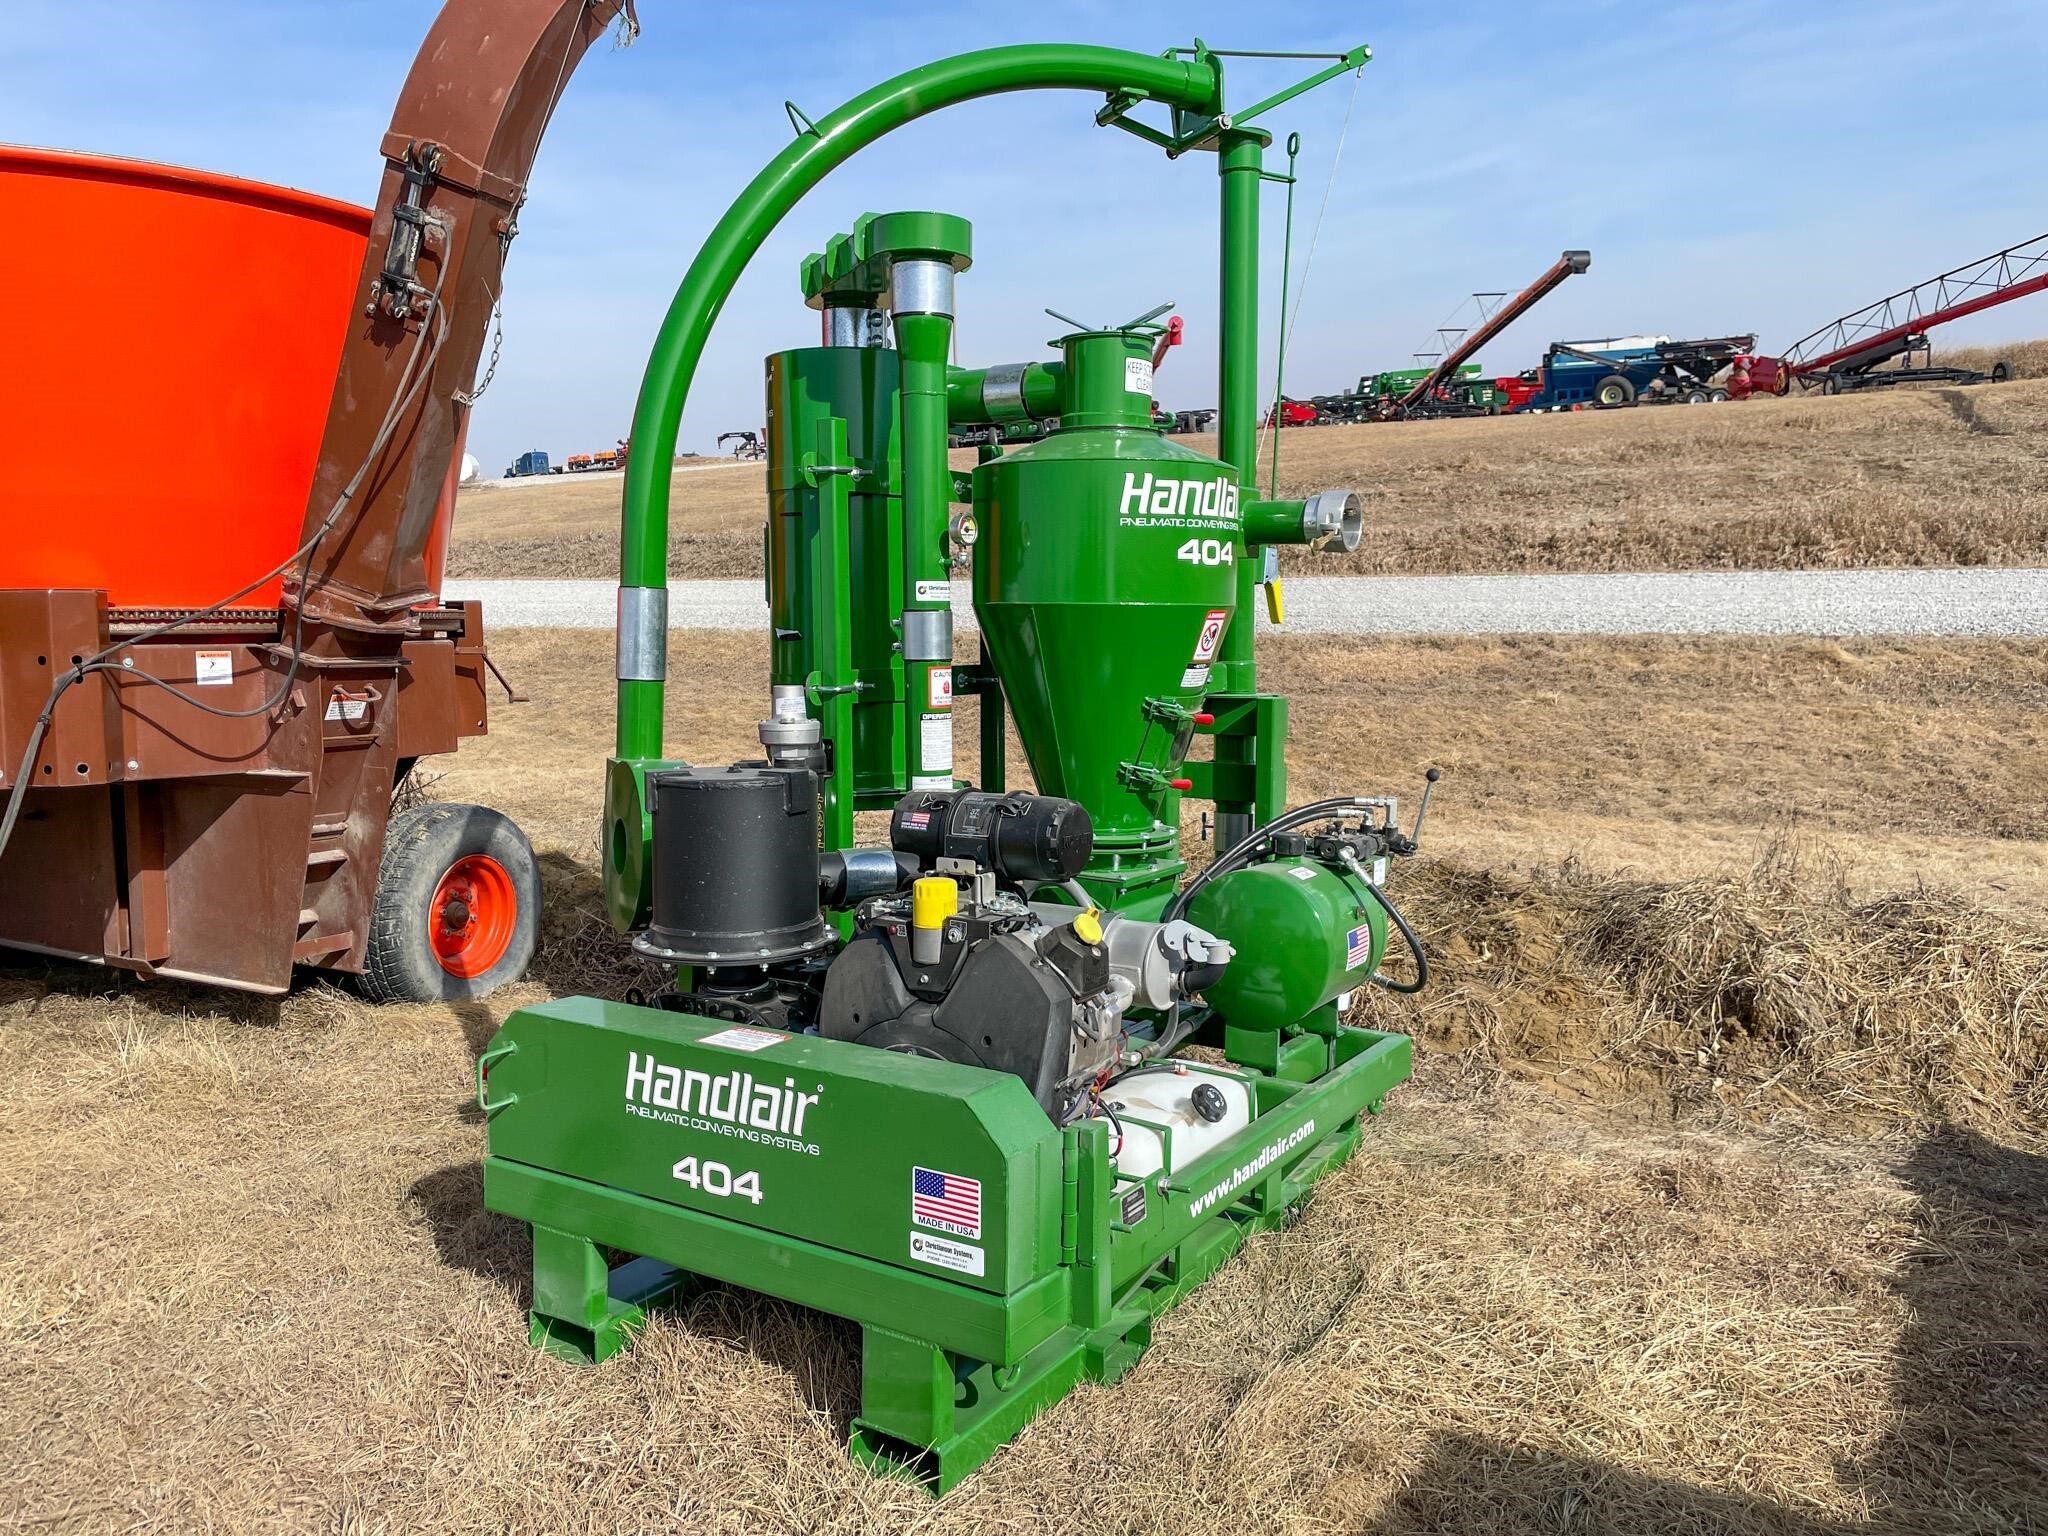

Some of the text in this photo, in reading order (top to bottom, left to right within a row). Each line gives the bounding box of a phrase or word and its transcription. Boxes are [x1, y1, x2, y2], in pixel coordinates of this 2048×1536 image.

[1119, 517, 1186, 527] PNEUMATIC
[1177, 538, 1233, 566] 404
[624, 1051, 820, 1137] Handlair
[625, 1103, 820, 1156] PNEUMATIC CONVEYING SYSTEMS
[672, 1155, 764, 1205] 404
[1190, 1119, 1315, 1218] www.handlair.com
[918, 1215, 975, 1238] MADE IN USA
